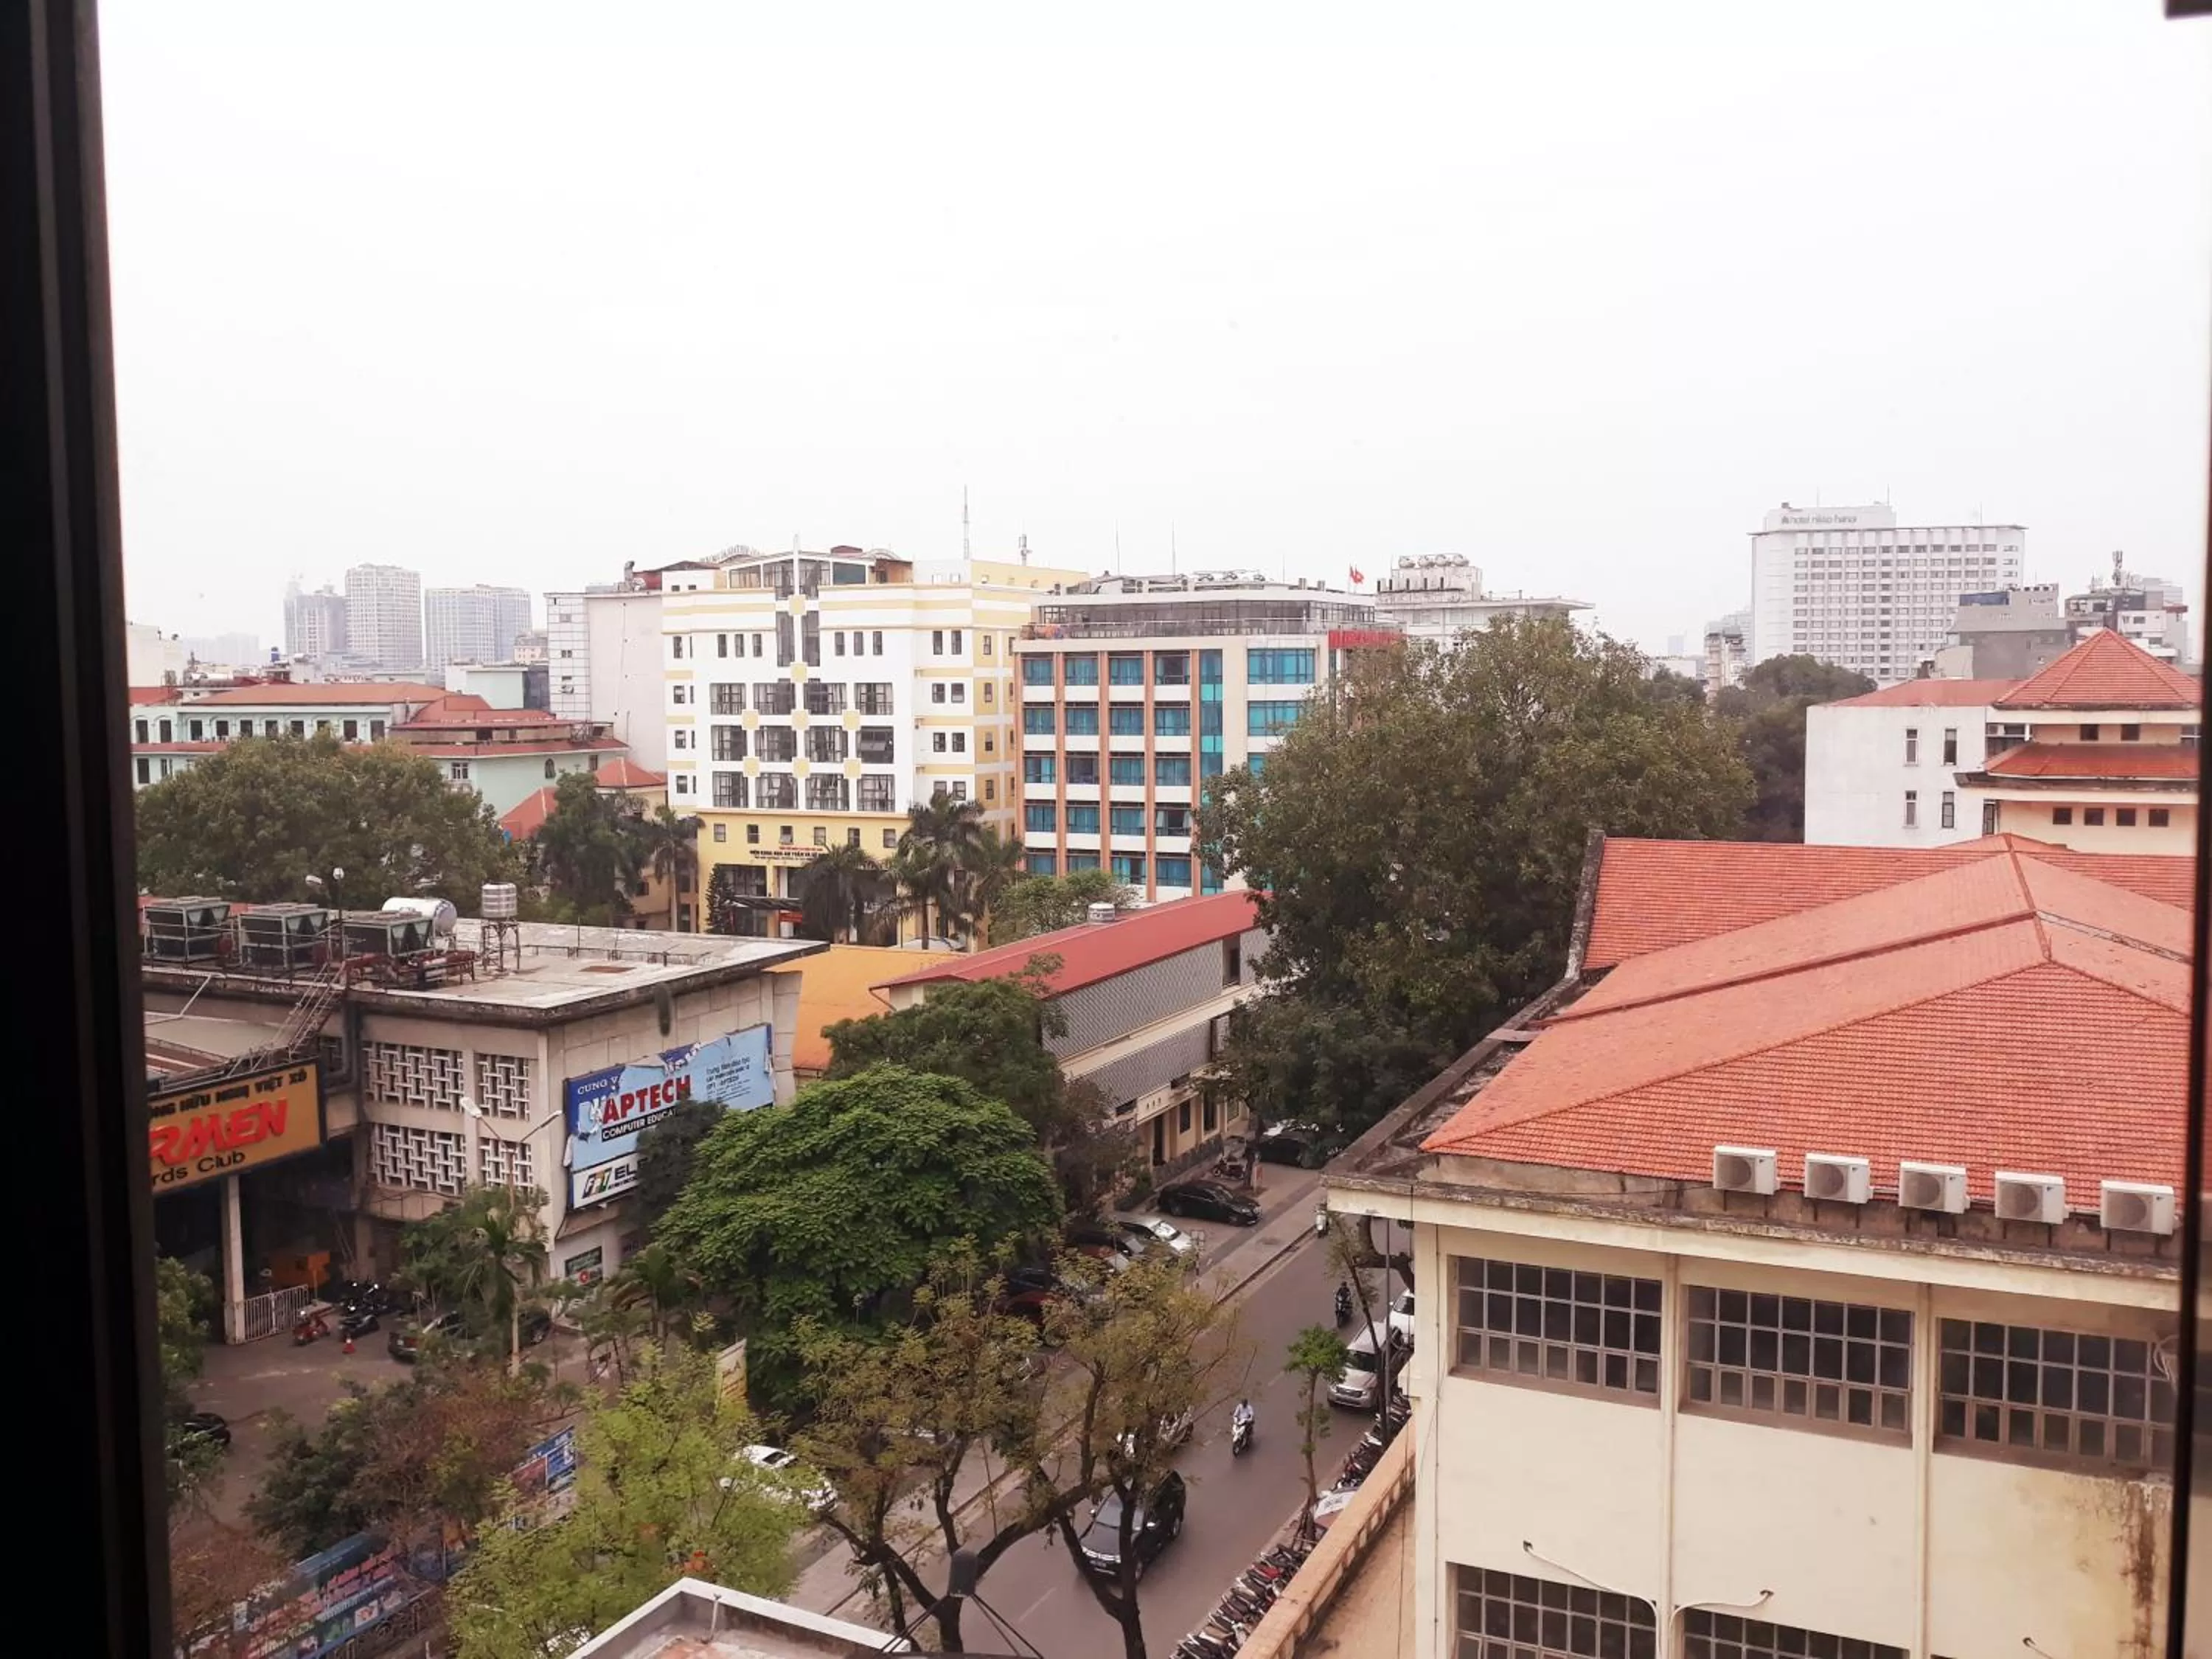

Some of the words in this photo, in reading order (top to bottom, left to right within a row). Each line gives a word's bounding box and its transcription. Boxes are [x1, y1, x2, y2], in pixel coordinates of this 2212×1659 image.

[602, 1074, 691, 1125] APTECH
[602, 1118, 646, 1139] COMPUTER
[197, 1150, 246, 1173] Club
